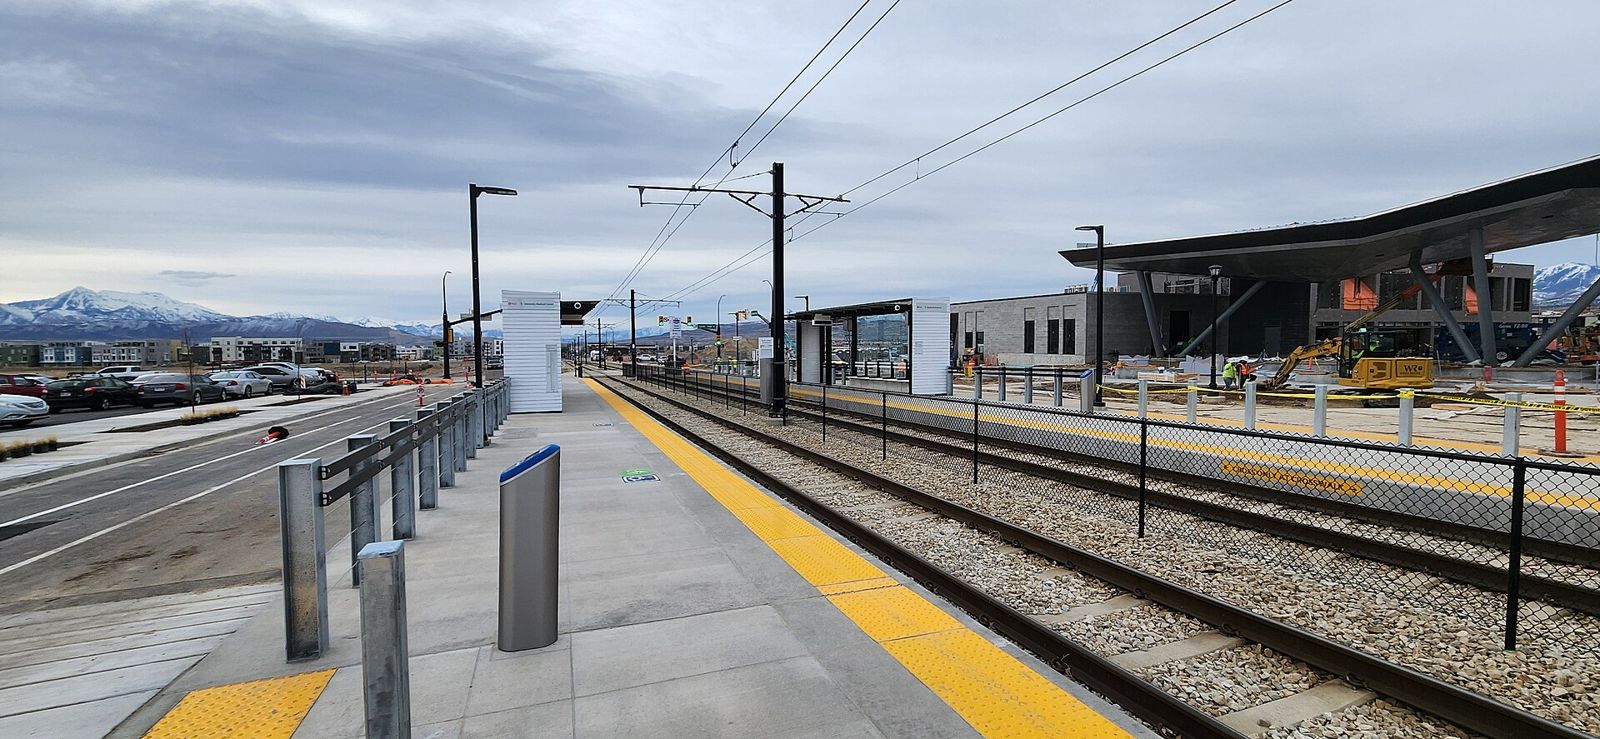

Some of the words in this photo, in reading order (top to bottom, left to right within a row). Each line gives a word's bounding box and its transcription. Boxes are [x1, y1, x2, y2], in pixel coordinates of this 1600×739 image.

[1232, 465, 1256, 476] CROSS
[1257, 469, 1277, 479] ONLY
[1279, 473, 1289, 482] AT
[1291, 475, 1344, 491] CROSSWALK
